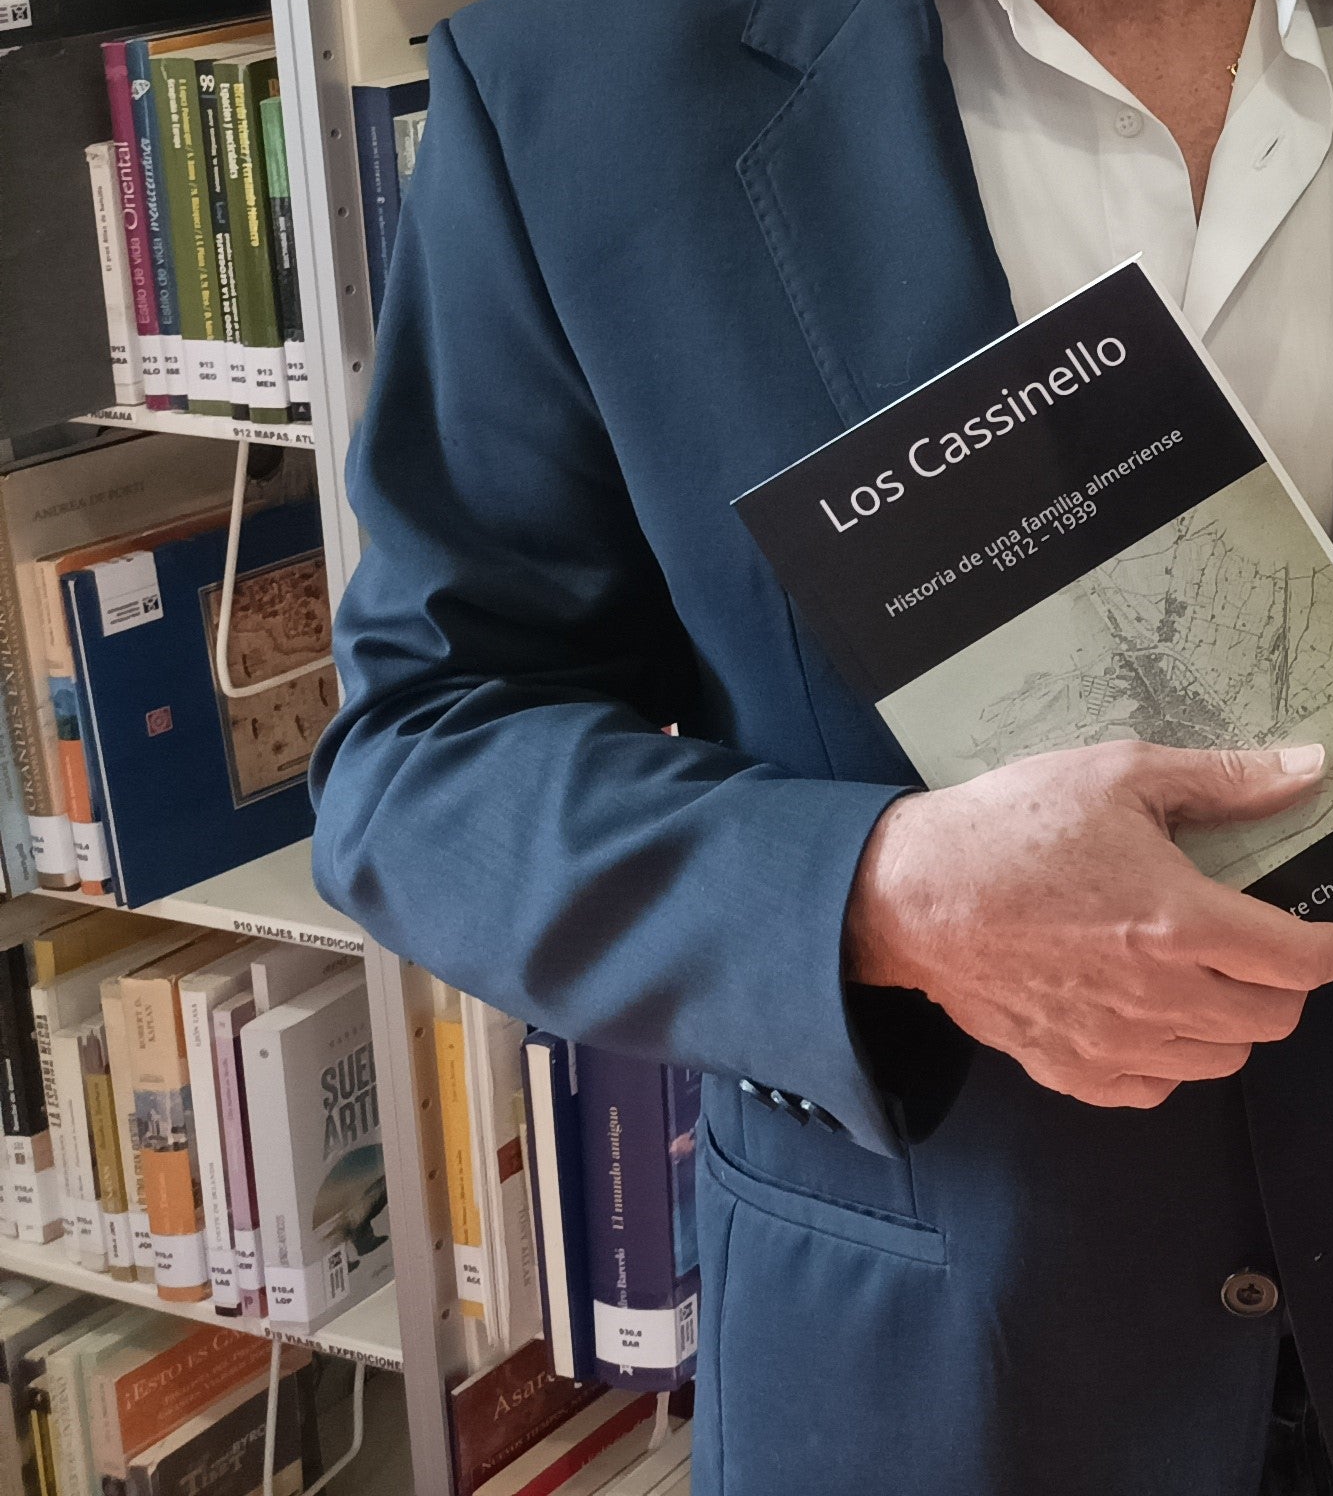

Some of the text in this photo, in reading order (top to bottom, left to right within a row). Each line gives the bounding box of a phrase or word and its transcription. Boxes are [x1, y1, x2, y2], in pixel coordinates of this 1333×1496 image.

[819, 333, 1128, 533] Los Cassinello
[884, 427, 1184, 618] Historia de una familia almeriense
[991, 536, 1040, 575] 1812
[1052, 500, 1099, 536] 1939
